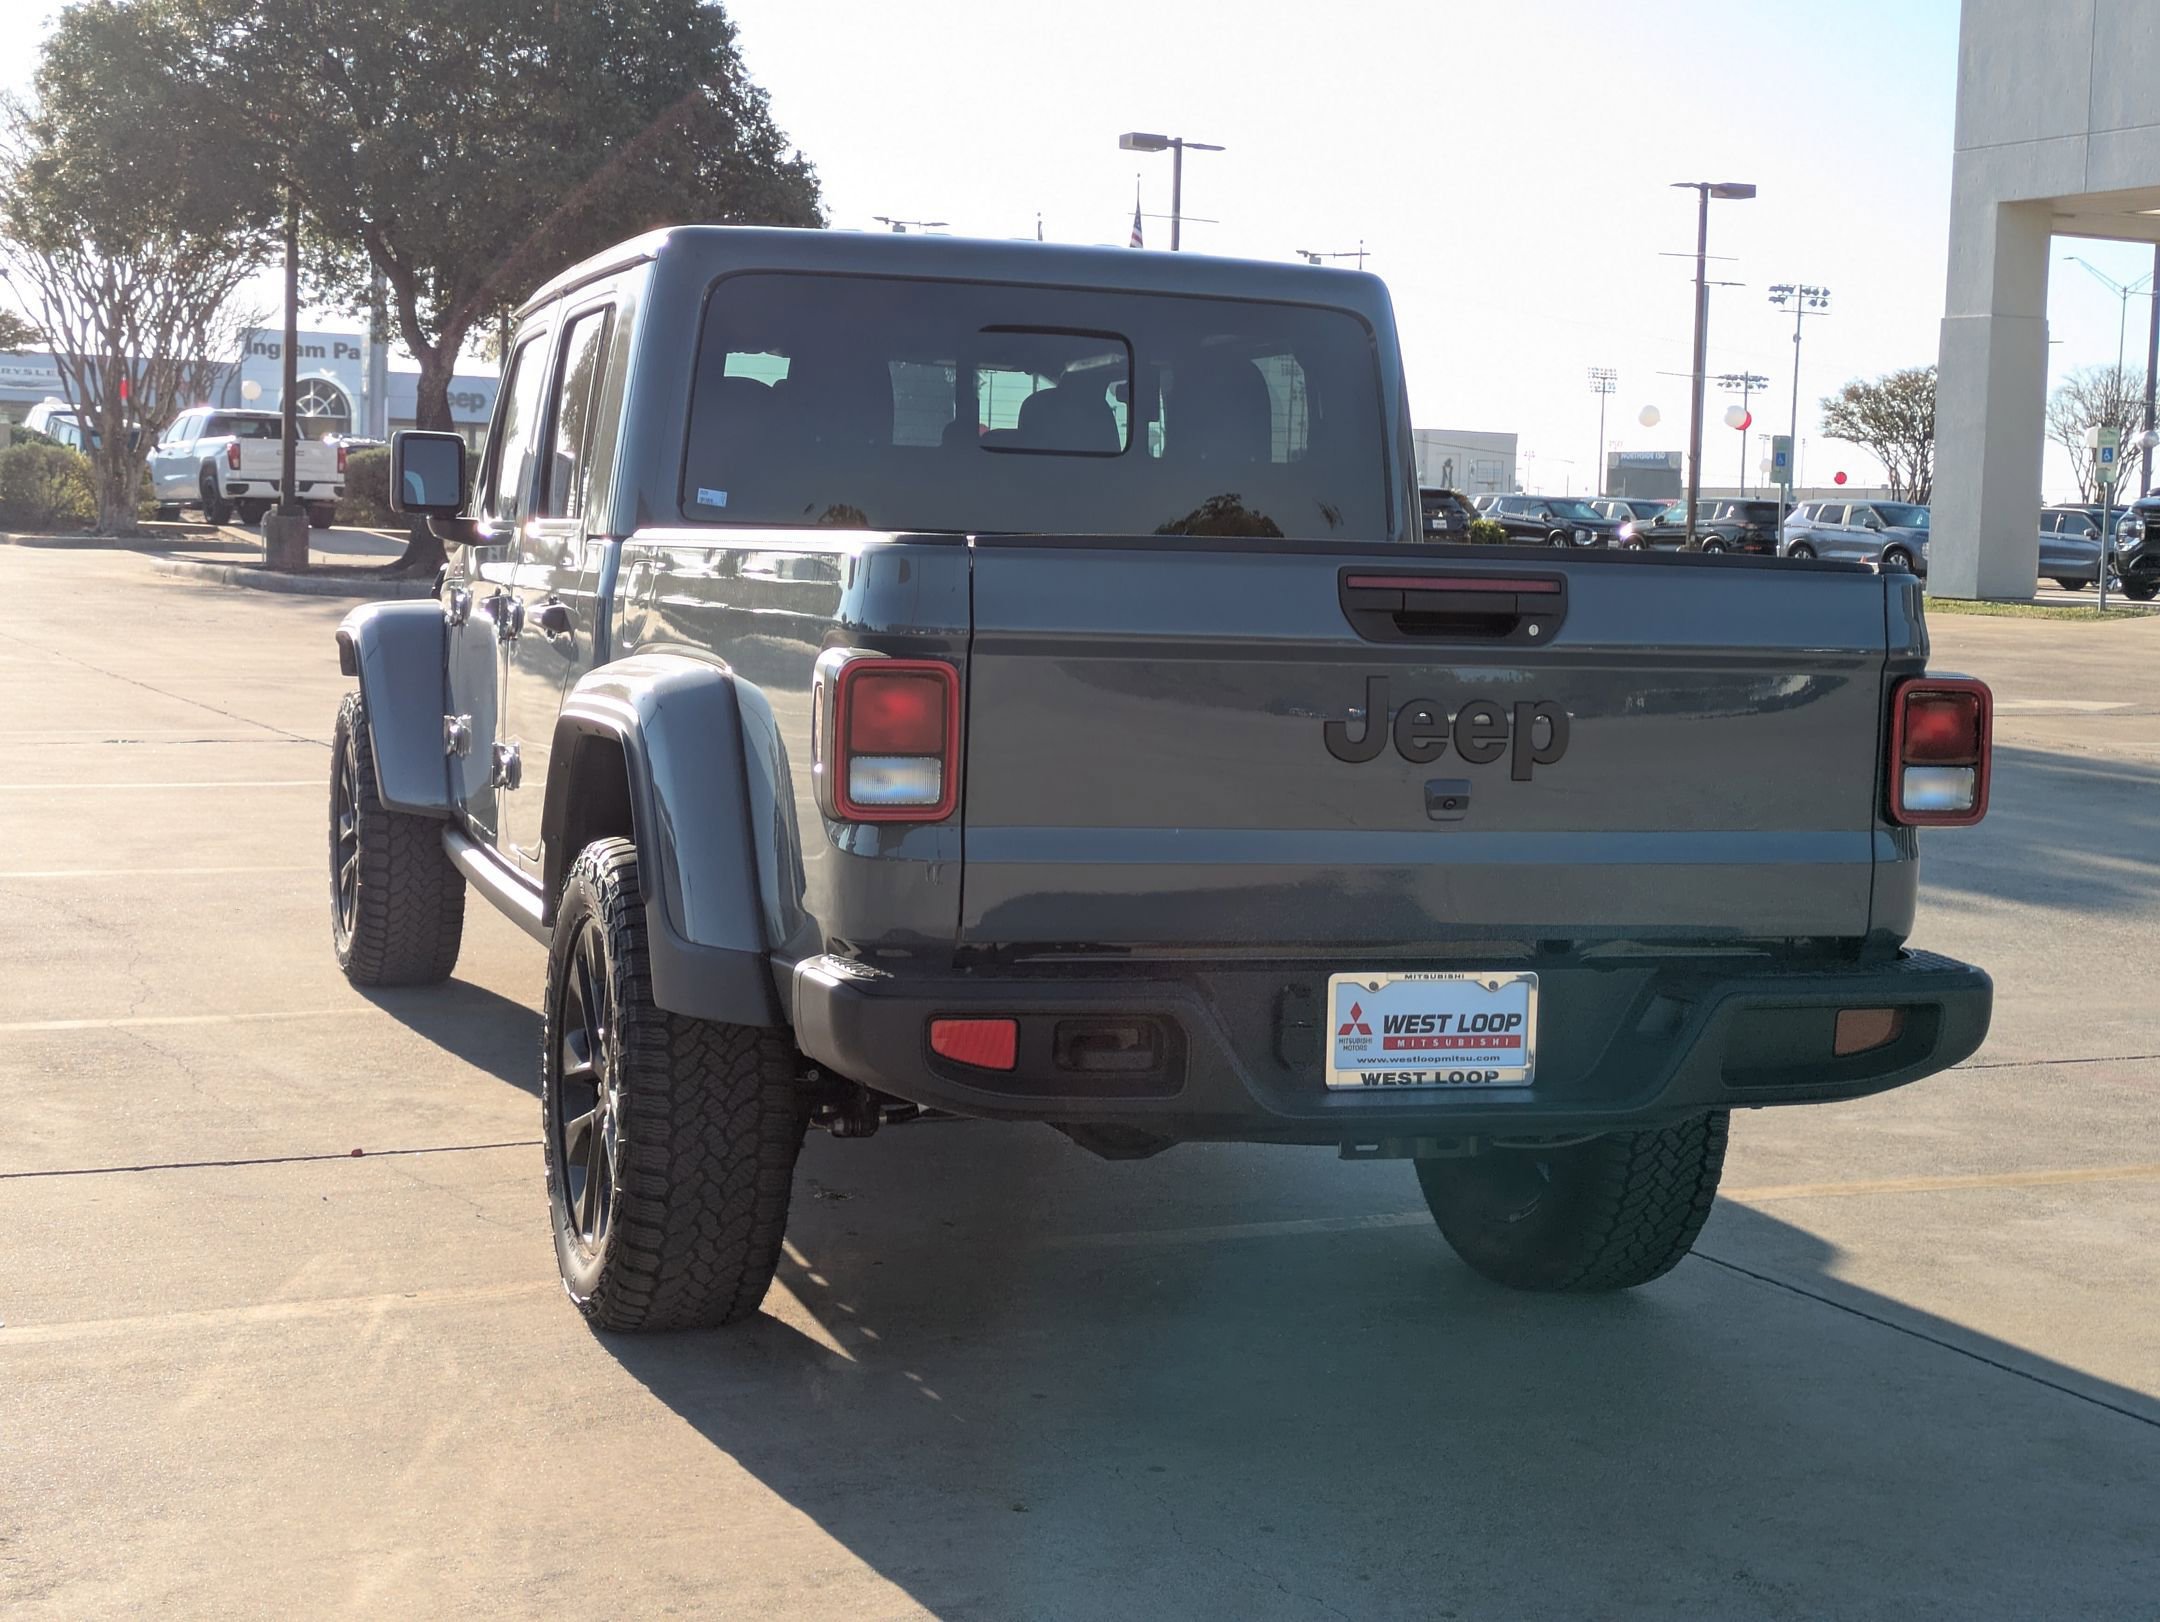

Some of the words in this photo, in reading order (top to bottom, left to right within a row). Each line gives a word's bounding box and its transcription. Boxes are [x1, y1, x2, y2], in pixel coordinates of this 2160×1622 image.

[245, 342, 325, 360] Ingam
[447, 391, 486, 413] eep
[1324, 675, 1571, 782] Jeep
[1383, 1013, 1453, 1034] WEST
[1457, 1013, 1522, 1034] LOOP
[1342, 1044, 1368, 1052] MOTORS
[1397, 1037, 1510, 1048] MITSUBISHI
[1357, 1055, 1500, 1064] www.westloopmitsu.com
[1360, 1072, 1427, 1087] WEST
[1434, 1070, 1500, 1085] LOOP
